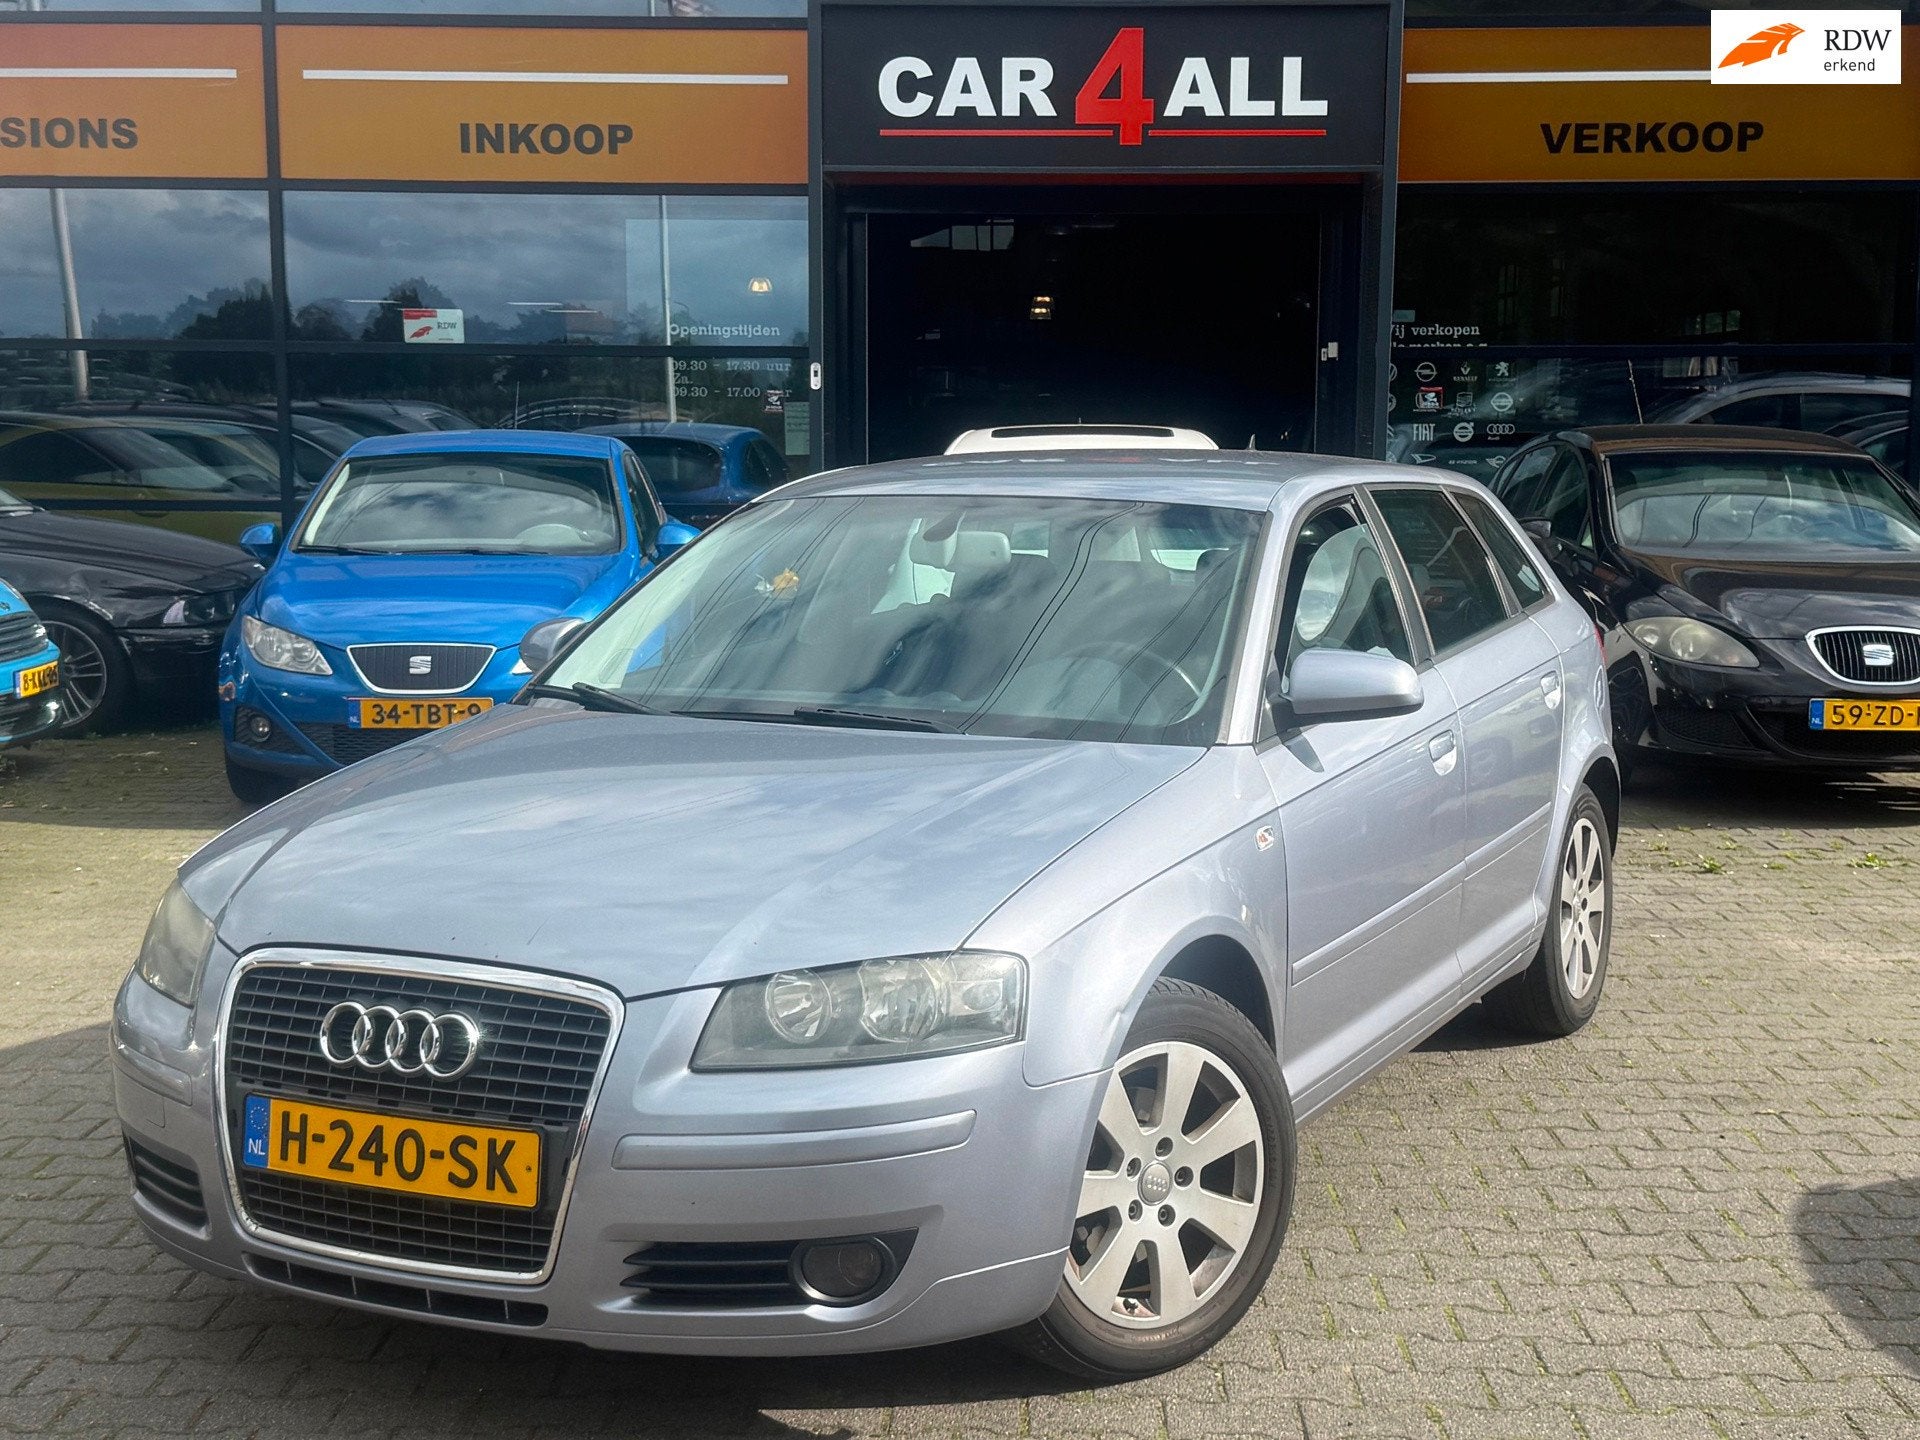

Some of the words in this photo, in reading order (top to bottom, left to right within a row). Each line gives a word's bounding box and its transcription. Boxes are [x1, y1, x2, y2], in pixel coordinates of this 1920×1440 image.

[878, 56, 1057, 117] CAR
[1075, 27, 1154, 146] 4
[1163, 56, 1328, 116] ALL
[460, 123, 633, 155] INKOOP
[1540, 121, 1764, 153] VERKOOP
[670, 324, 780, 338] Openingstijden
[1411, 324, 1480, 338] verkopen
[726, 360, 760, 371] 17.30
[766, 362, 792, 371] uur
[727, 387, 760, 398] 17.00
[1413, 423, 1435, 441] FIAT
[1831, 704, 1920, 726] 59-ZD-
[248, 1138, 266, 1155] NL
[279, 1110, 518, 1194] H-240-SK
